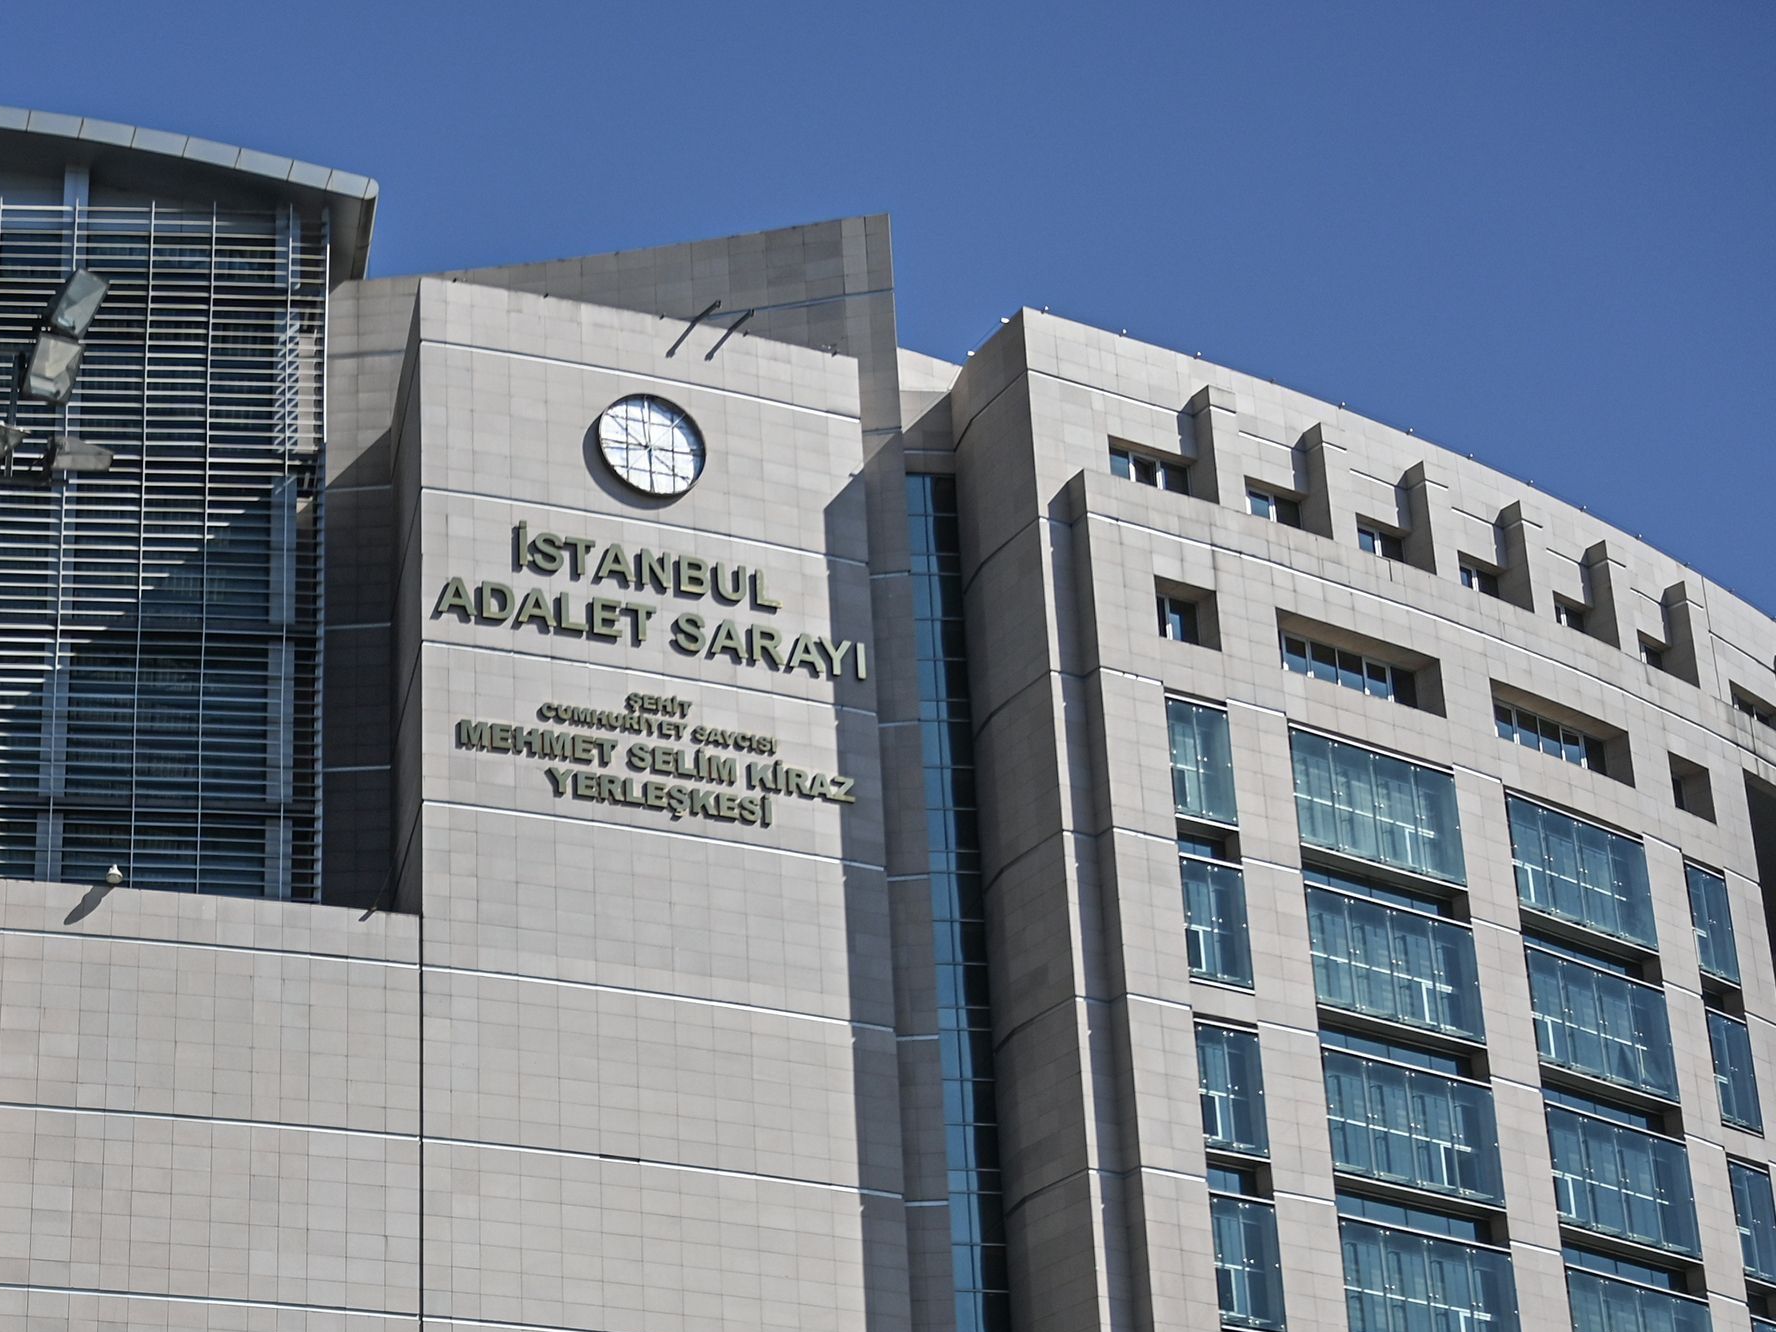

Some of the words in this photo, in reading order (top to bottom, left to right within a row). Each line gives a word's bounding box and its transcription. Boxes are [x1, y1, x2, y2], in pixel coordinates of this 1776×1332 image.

[517, 519, 783, 609] İSTANBUL
[437, 576, 657, 642] ADALET
[674, 612, 867, 680] SARAYI
[626, 692, 692, 719] ŞEHİT
[458, 718, 618, 765] MEHMET
[629, 742, 737, 785] SELİM
[749, 759, 856, 804] KİRAZ
[548, 766, 773, 827] YERLEŞKESİ
